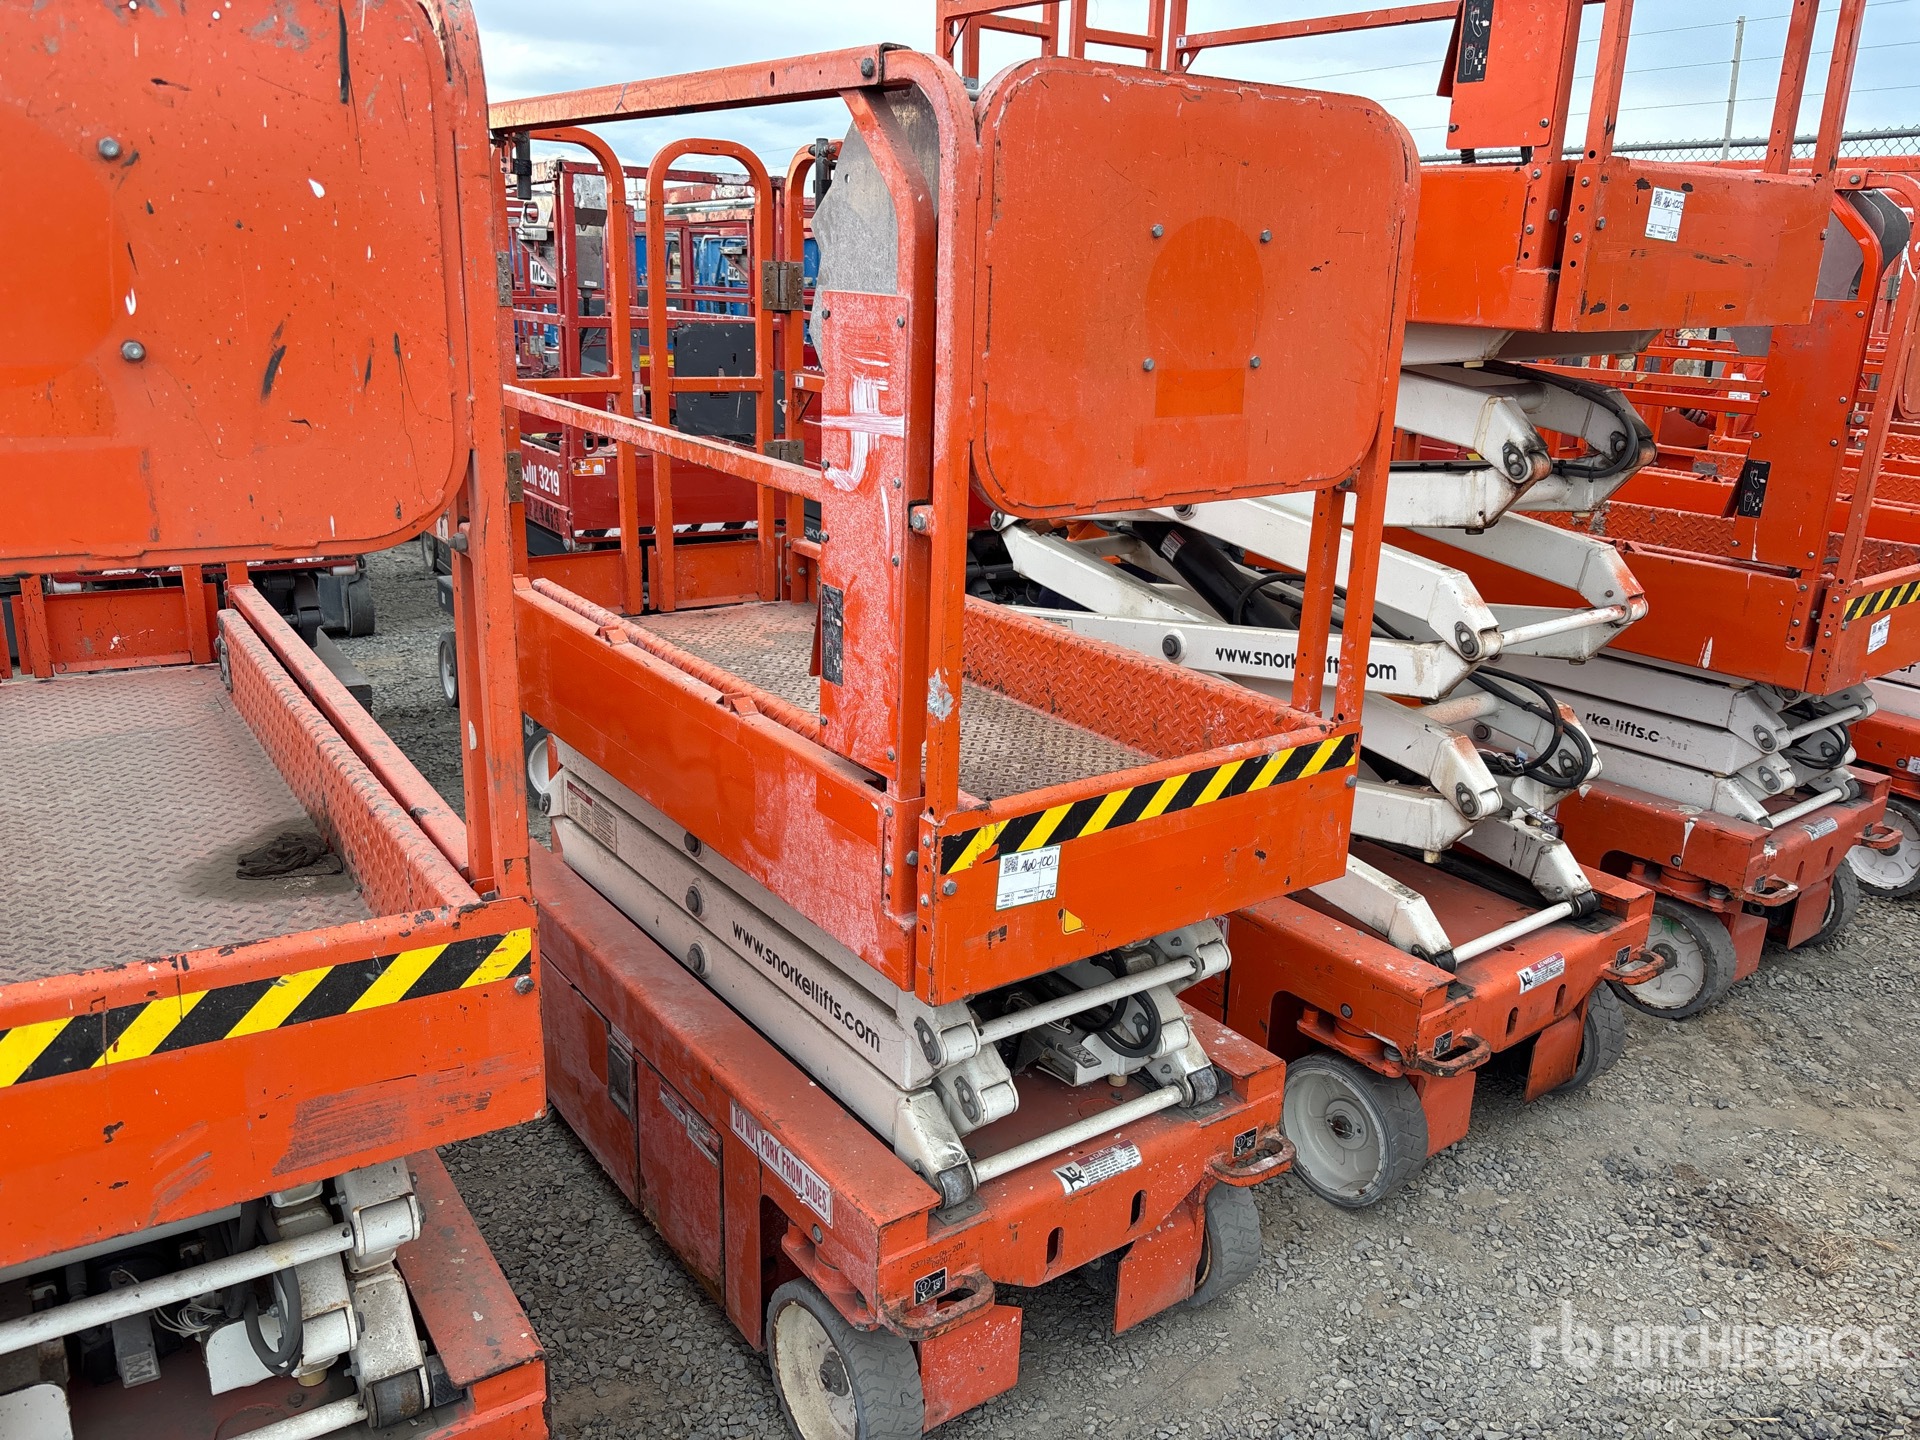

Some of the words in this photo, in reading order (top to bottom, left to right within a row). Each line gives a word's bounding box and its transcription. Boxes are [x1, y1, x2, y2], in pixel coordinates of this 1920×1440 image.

[532, 264, 545, 281] MC
[539, 464, 560, 496] 3219
[732, 920, 880, 1053] www.snorkellifts.com
[734, 1109, 744, 1131] DO
[745, 1115, 759, 1144] NOT
[760, 1134, 780, 1168] FORK
[781, 1151, 803, 1190] FROM
[804, 1173, 827, 1213] SIDES
